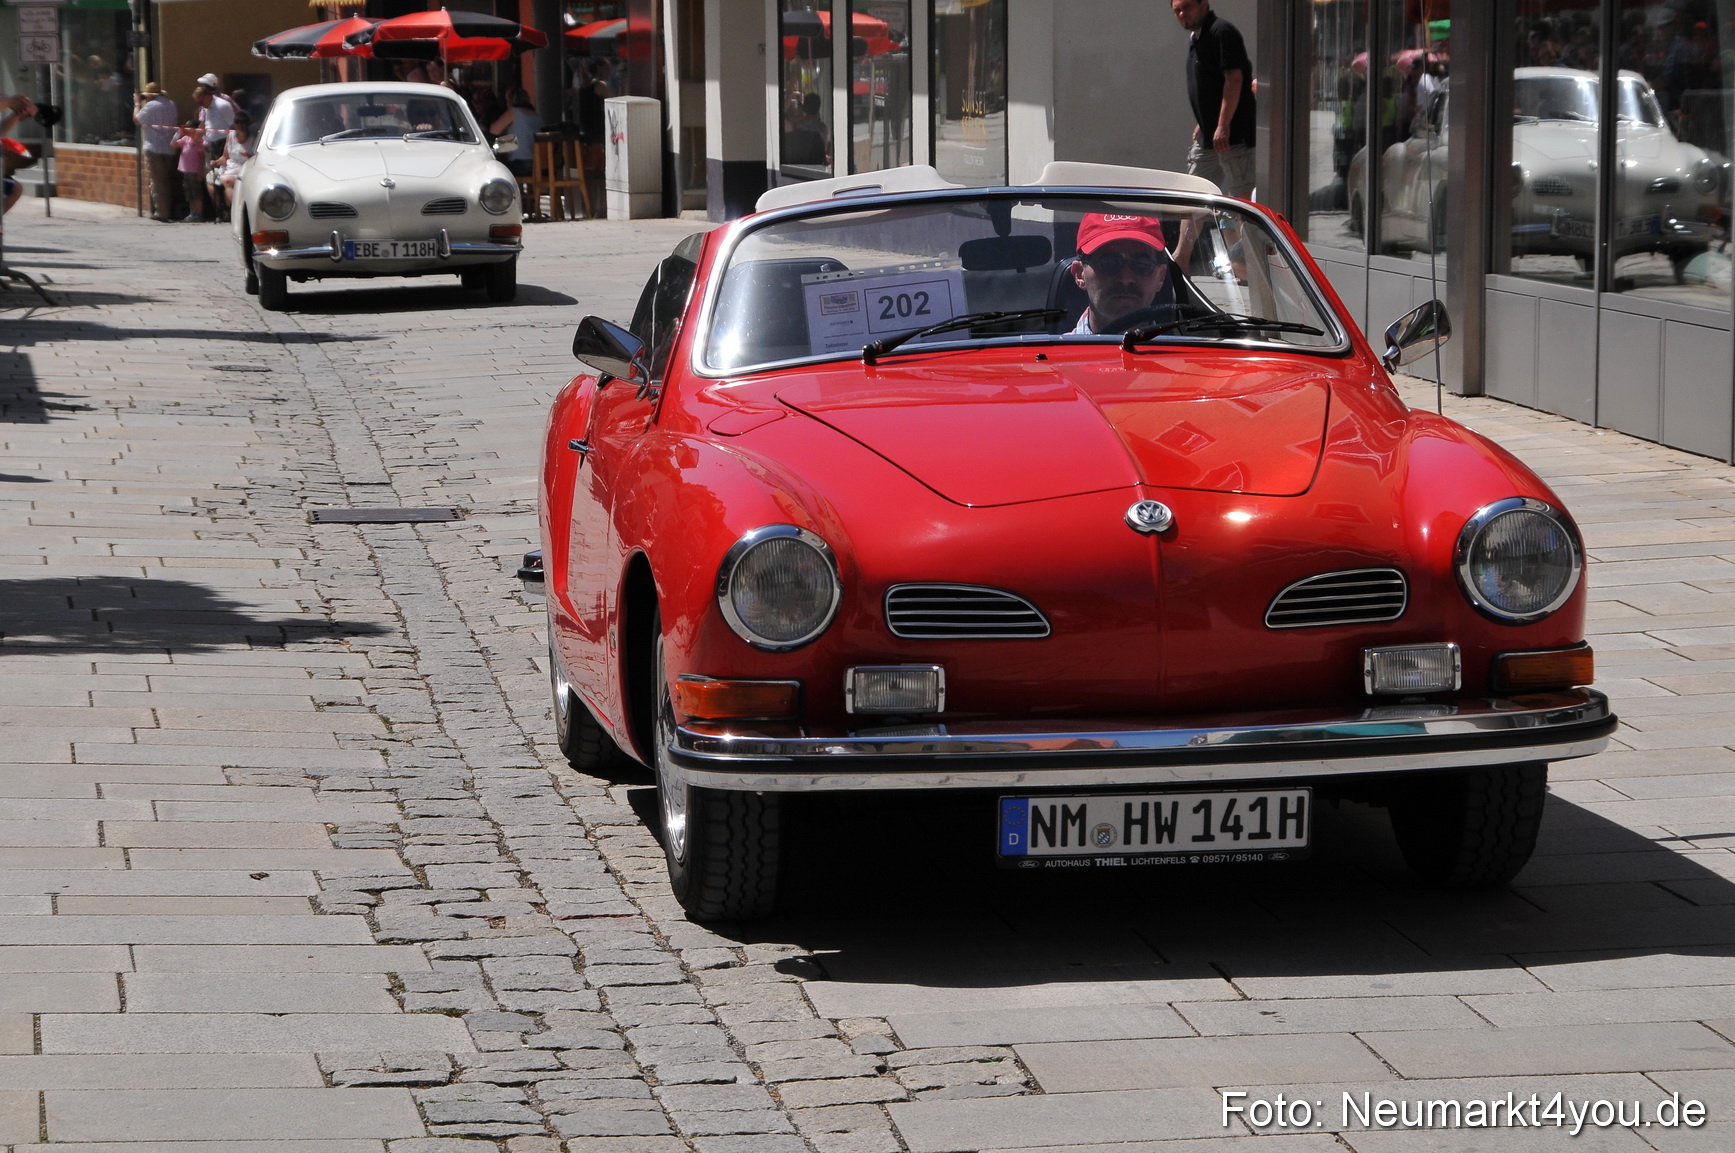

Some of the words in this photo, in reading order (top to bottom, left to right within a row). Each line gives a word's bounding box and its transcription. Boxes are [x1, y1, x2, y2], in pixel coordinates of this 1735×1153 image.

[354, 243, 380, 257] EBE
[390, 243, 398, 257] T
[402, 243, 436, 257] 118H
[878, 291, 931, 320] 202
[1031, 803, 1087, 848] NM
[1123, 801, 1179, 845] HW
[1191, 796, 1305, 843] 141H
[1008, 833, 1018, 846] D
[1045, 859, 1091, 867] AUTOHAUS
[1094, 857, 1128, 866] THIEL
[1131, 856, 1186, 866] LICHTENFELS
[1202, 853, 1263, 863] 09571/95140
